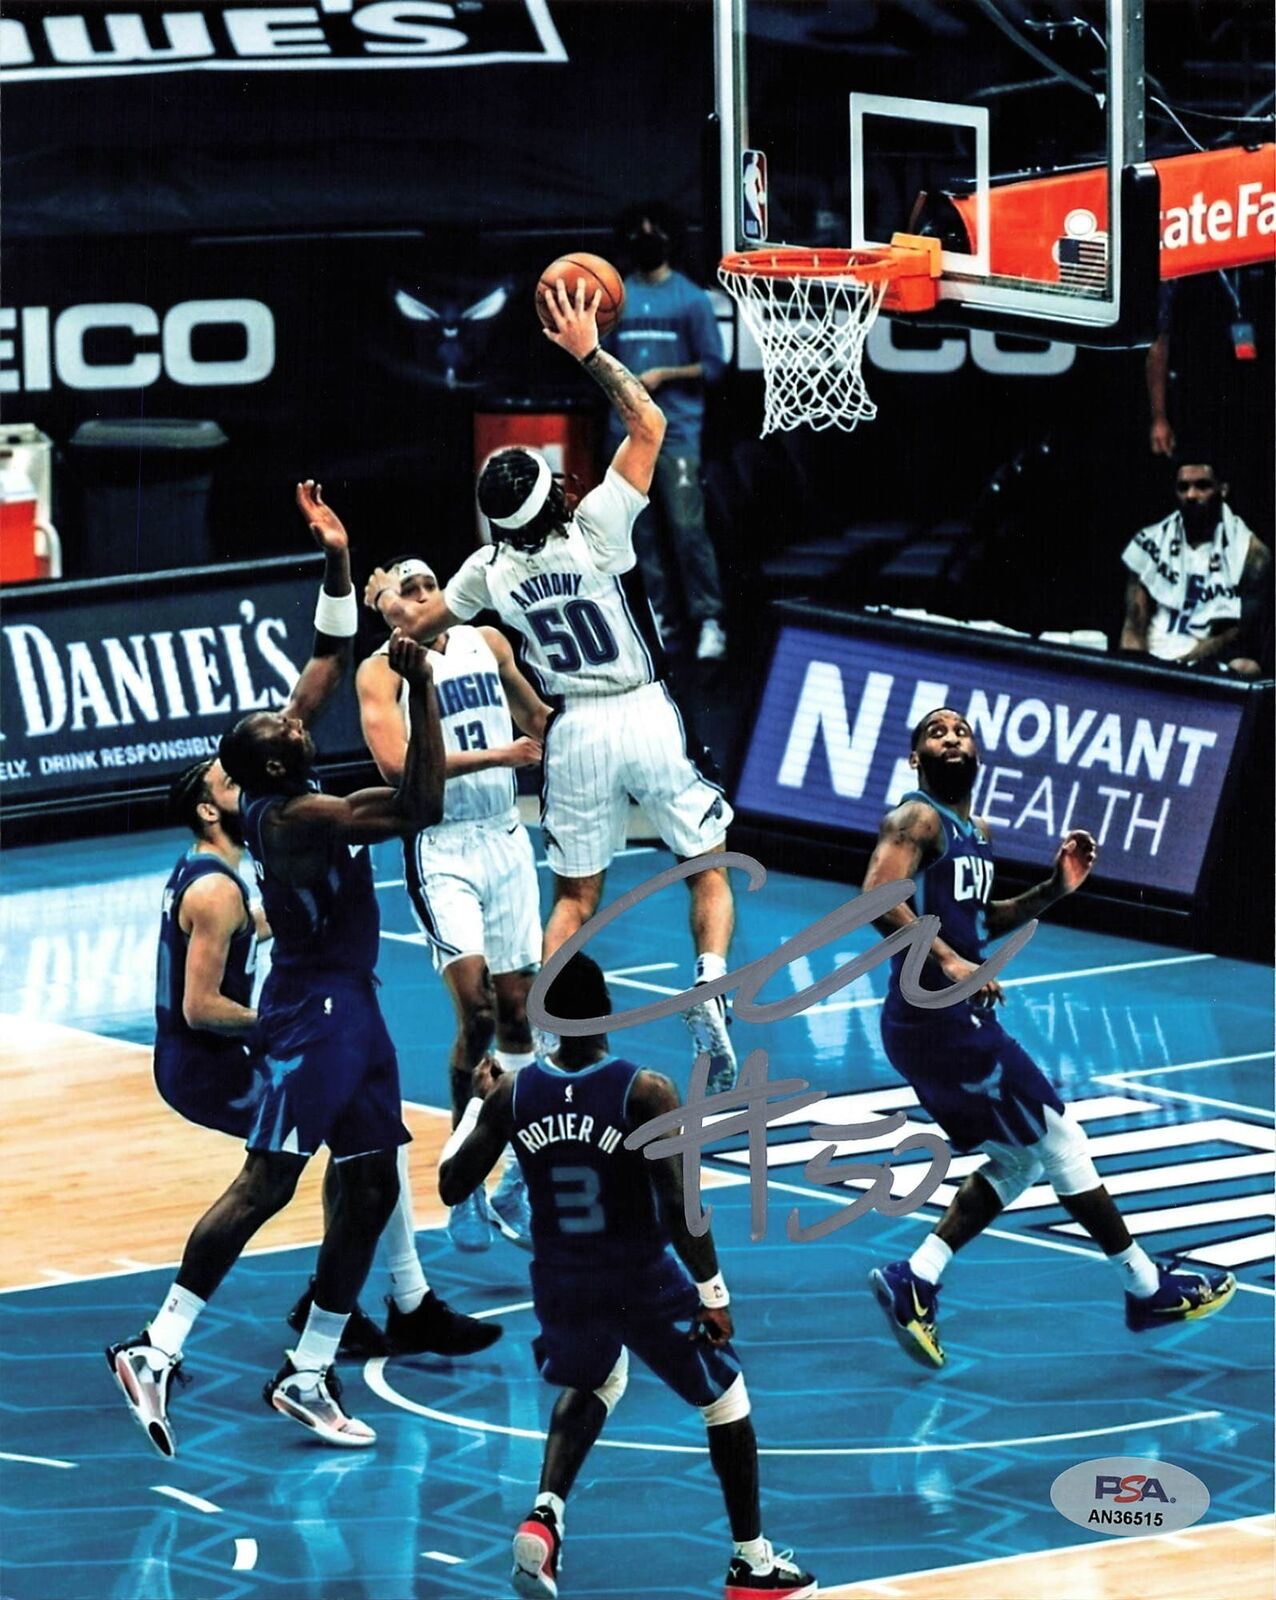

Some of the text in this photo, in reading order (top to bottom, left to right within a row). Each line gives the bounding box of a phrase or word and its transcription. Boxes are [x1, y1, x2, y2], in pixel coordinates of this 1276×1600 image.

[510, 573, 582, 610] ANTHONY
[525, 599, 620, 673] 50
[2, 599, 301, 738] DANIEL'S
[38, 749, 99, 776] DRINK
[454, 719, 488, 752] 13
[965, 689, 1218, 787] NOVANT
[517, 1113, 623, 1154] ROZIER III
[552, 1166, 606, 1233] 3
